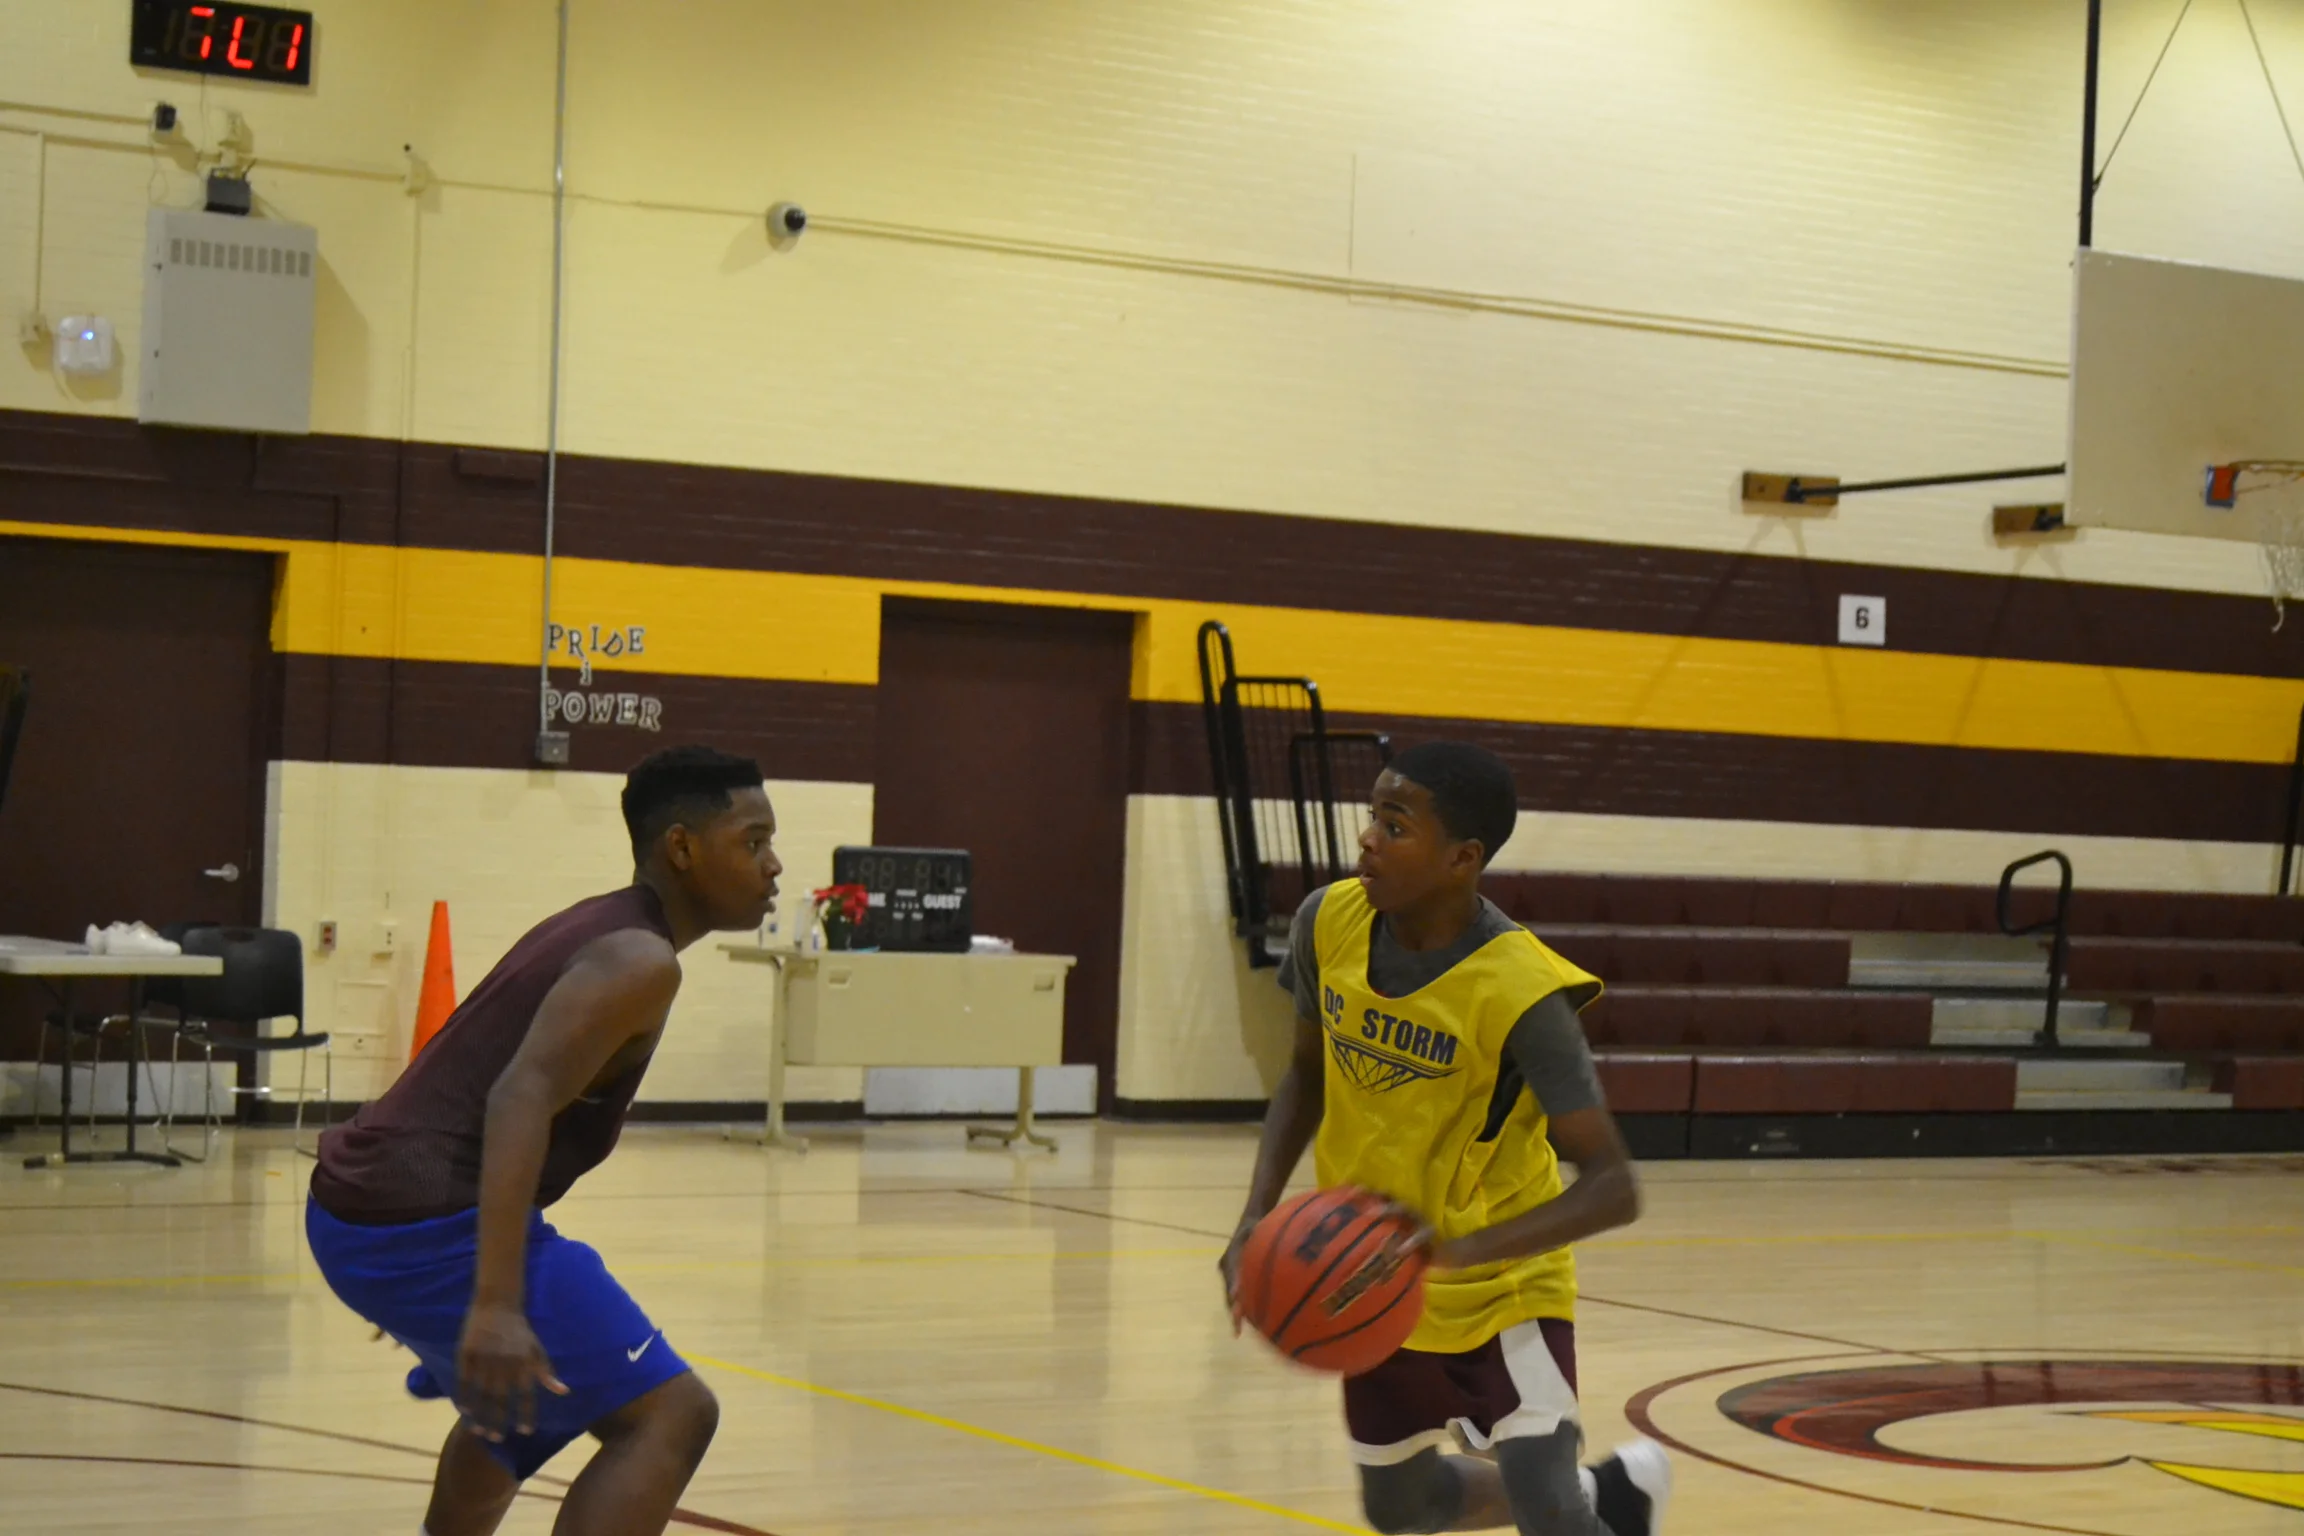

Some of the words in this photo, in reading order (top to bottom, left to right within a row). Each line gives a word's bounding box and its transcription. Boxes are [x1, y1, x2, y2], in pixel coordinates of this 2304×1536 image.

[1855, 606, 1869, 629] 6
[548, 624, 645, 657] PRIDE
[544, 689, 662, 732] POWER
[922, 894, 961, 909] GUEST
[1324, 984, 1344, 1025] DC
[1361, 1008, 1458, 1065] STORM
